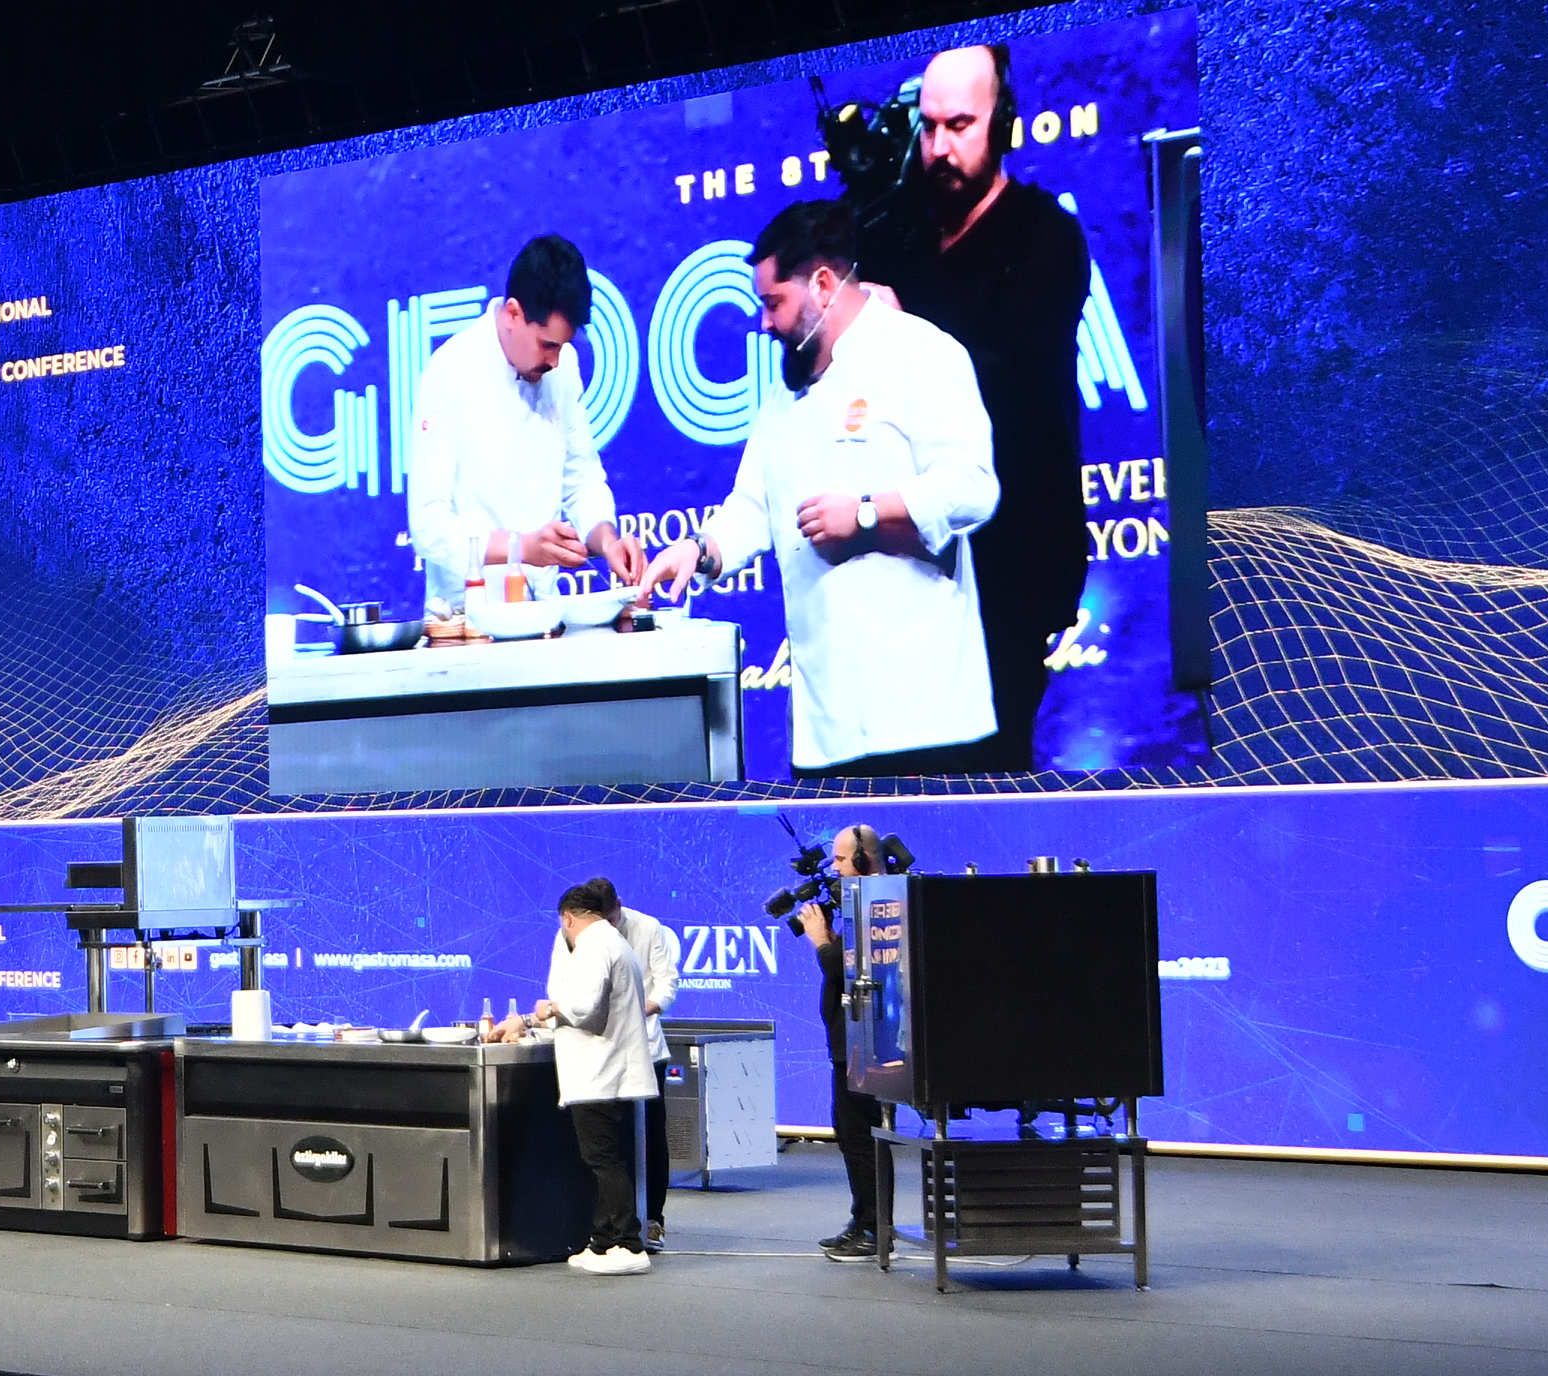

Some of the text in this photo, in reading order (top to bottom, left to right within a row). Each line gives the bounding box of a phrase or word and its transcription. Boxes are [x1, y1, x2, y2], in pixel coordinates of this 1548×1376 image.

[675, 149, 830, 205] THE 8T
[2, 343, 126, 383] CONFERENCE
[314, 951, 471, 970] www.gastromasa.com
